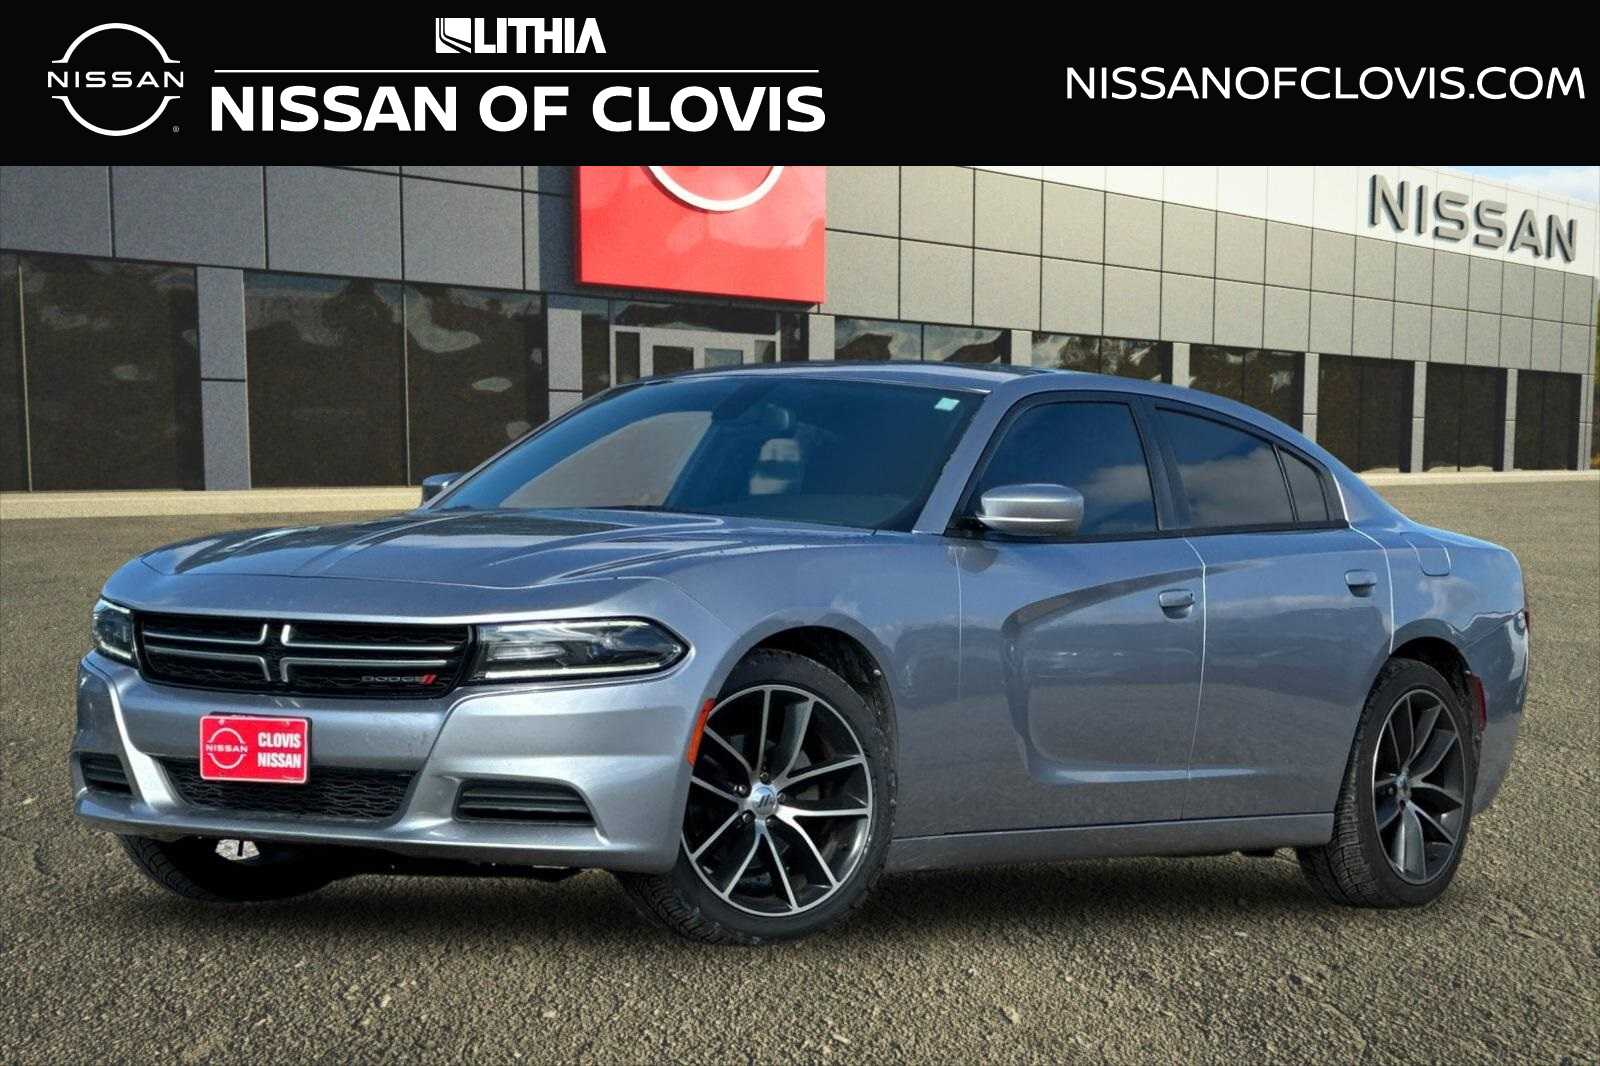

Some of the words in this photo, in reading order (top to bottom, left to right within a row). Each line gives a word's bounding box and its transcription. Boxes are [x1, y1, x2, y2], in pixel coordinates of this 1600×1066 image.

[1369, 174, 1577, 263] NISSAN
[205, 743, 248, 753] NISSAN
[257, 731, 302, 749] CLOVIS
[257, 752, 302, 769] NISSAN
